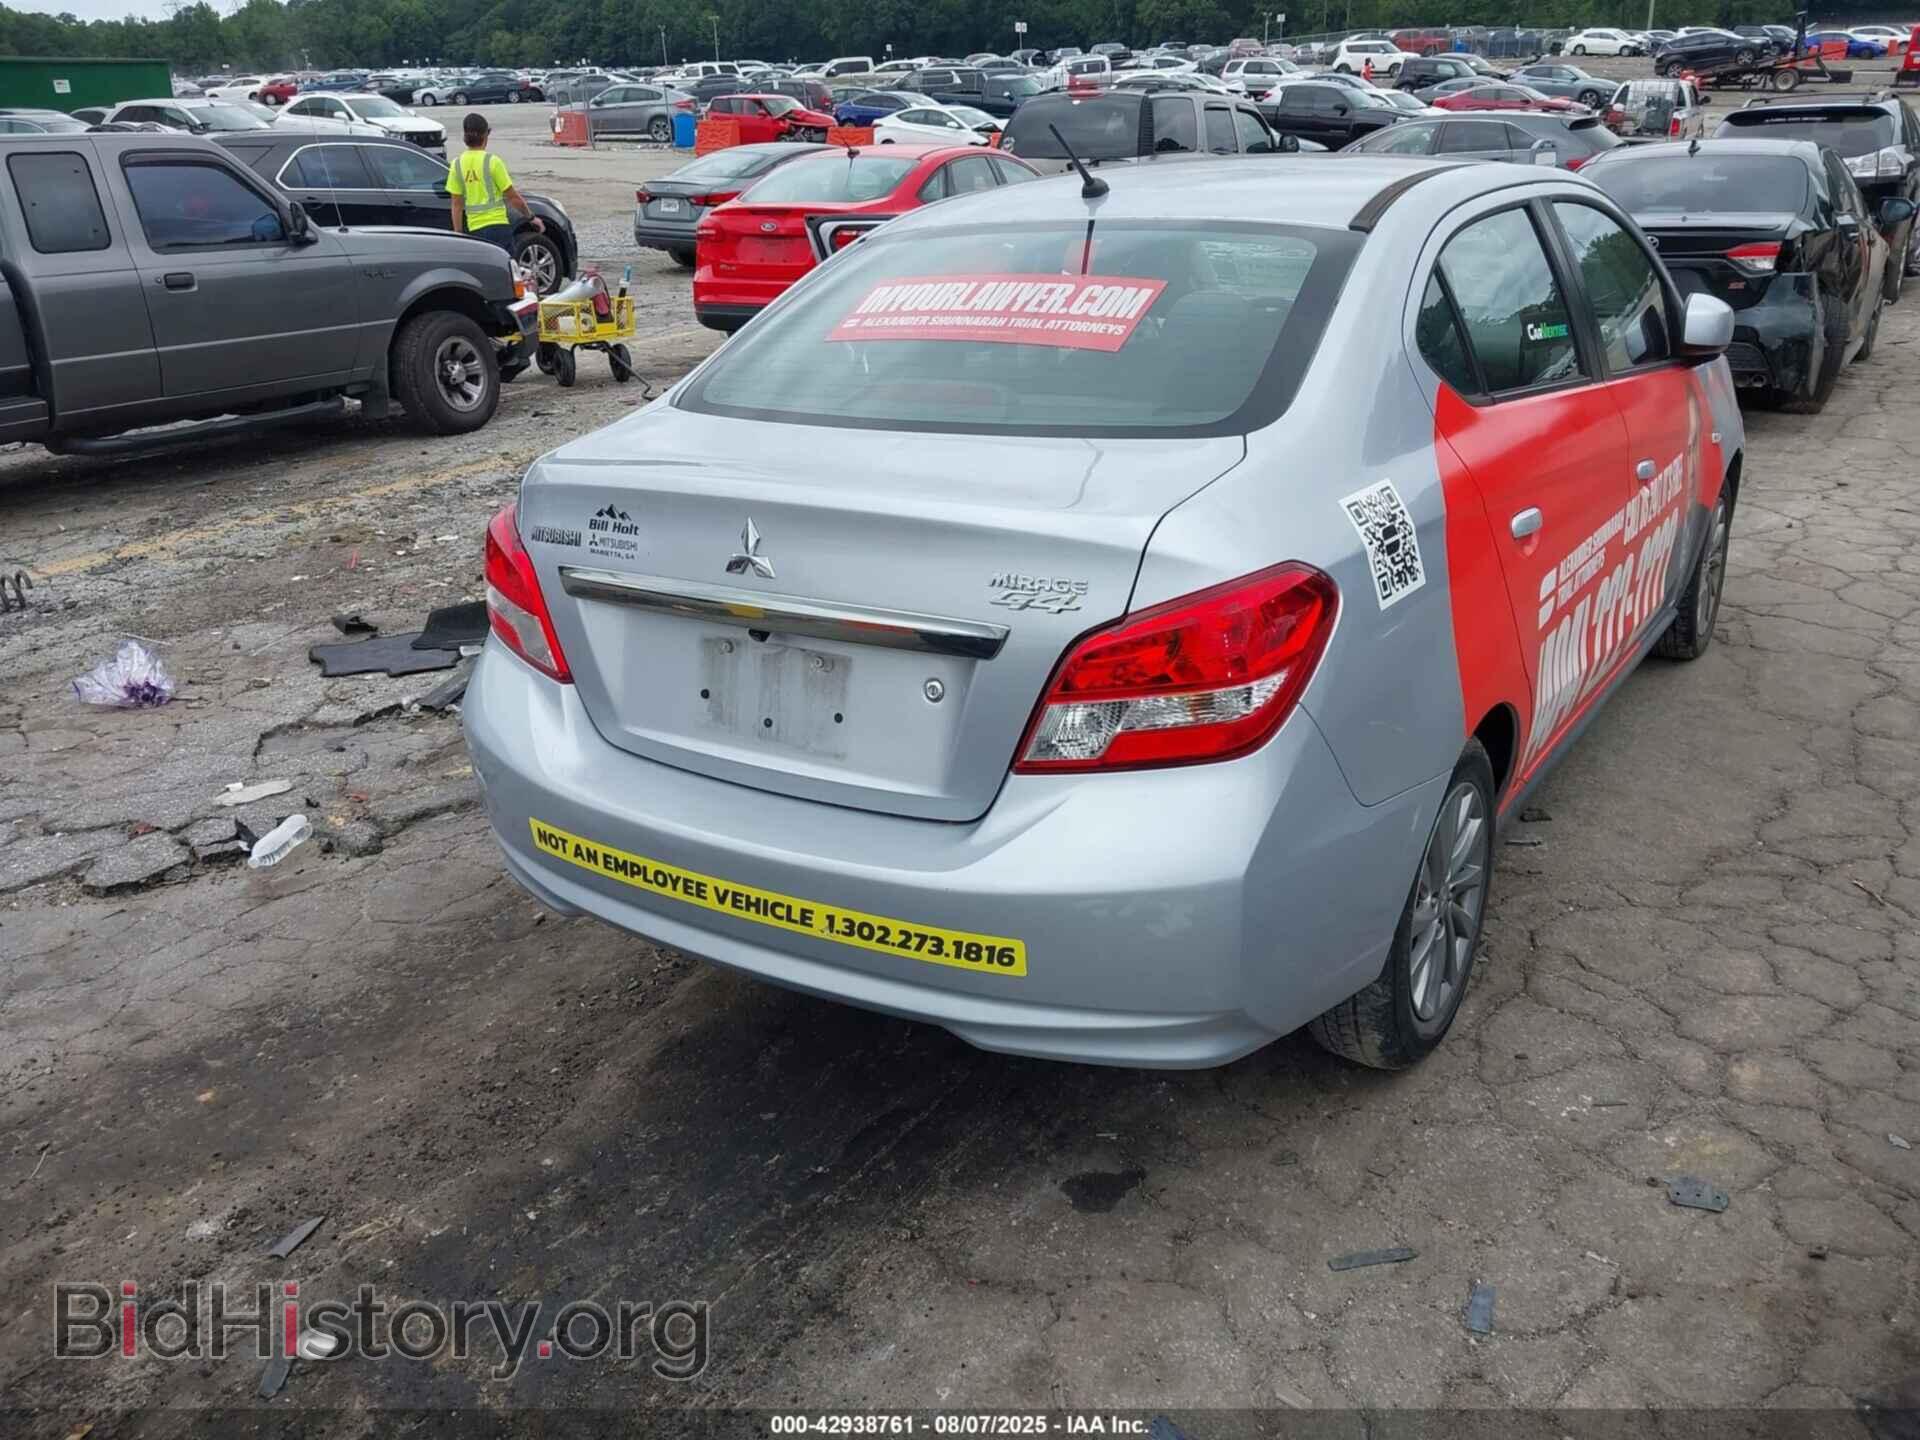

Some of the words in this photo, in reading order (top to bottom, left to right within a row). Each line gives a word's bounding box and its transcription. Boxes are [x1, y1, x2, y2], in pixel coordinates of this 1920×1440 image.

[1007, 317, 1047, 329] TRIAL
[1044, 319, 1127, 336] ATTORNEYS
[589, 518, 609, 532] Bill
[612, 521, 640, 536] Holt
[989, 573, 1088, 595] MIRAGE
[537, 826, 568, 856] NOT
[573, 842, 599, 866] AN
[603, 852, 708, 901] EMPLOYEE
[713, 886, 814, 928] VEHICLE
[824, 913, 1016, 967] 1.302.273.1816
